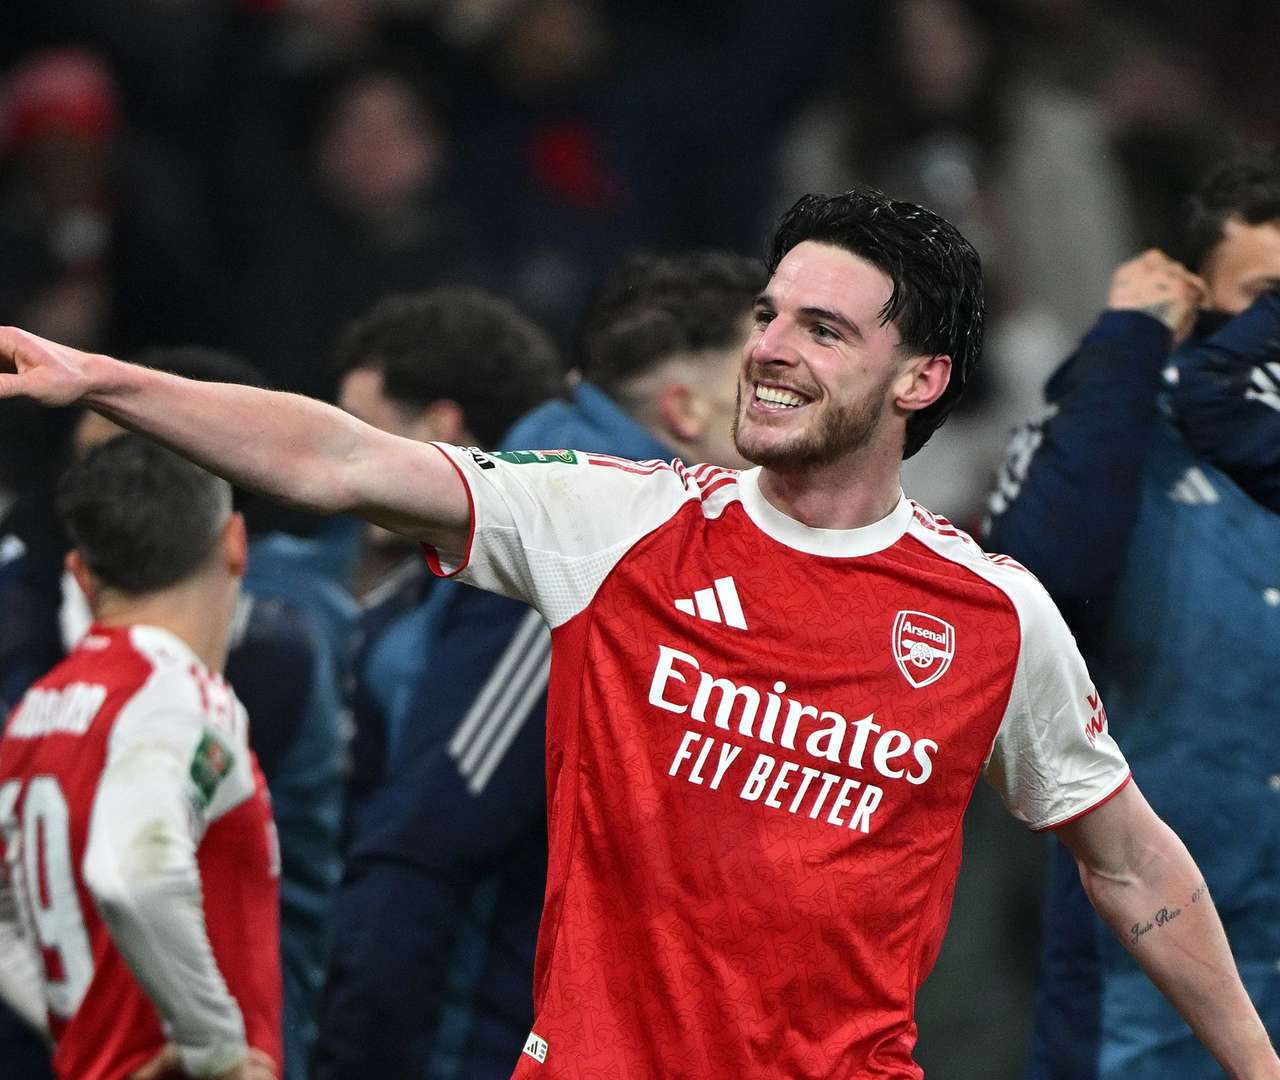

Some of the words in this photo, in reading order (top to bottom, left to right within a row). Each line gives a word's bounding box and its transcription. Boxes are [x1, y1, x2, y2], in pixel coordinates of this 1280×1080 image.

[903, 621, 946, 645] Arsenal
[648, 644, 939, 785] Emirates
[668, 730, 743, 791] FLY
[739, 753, 885, 834] BETTER
